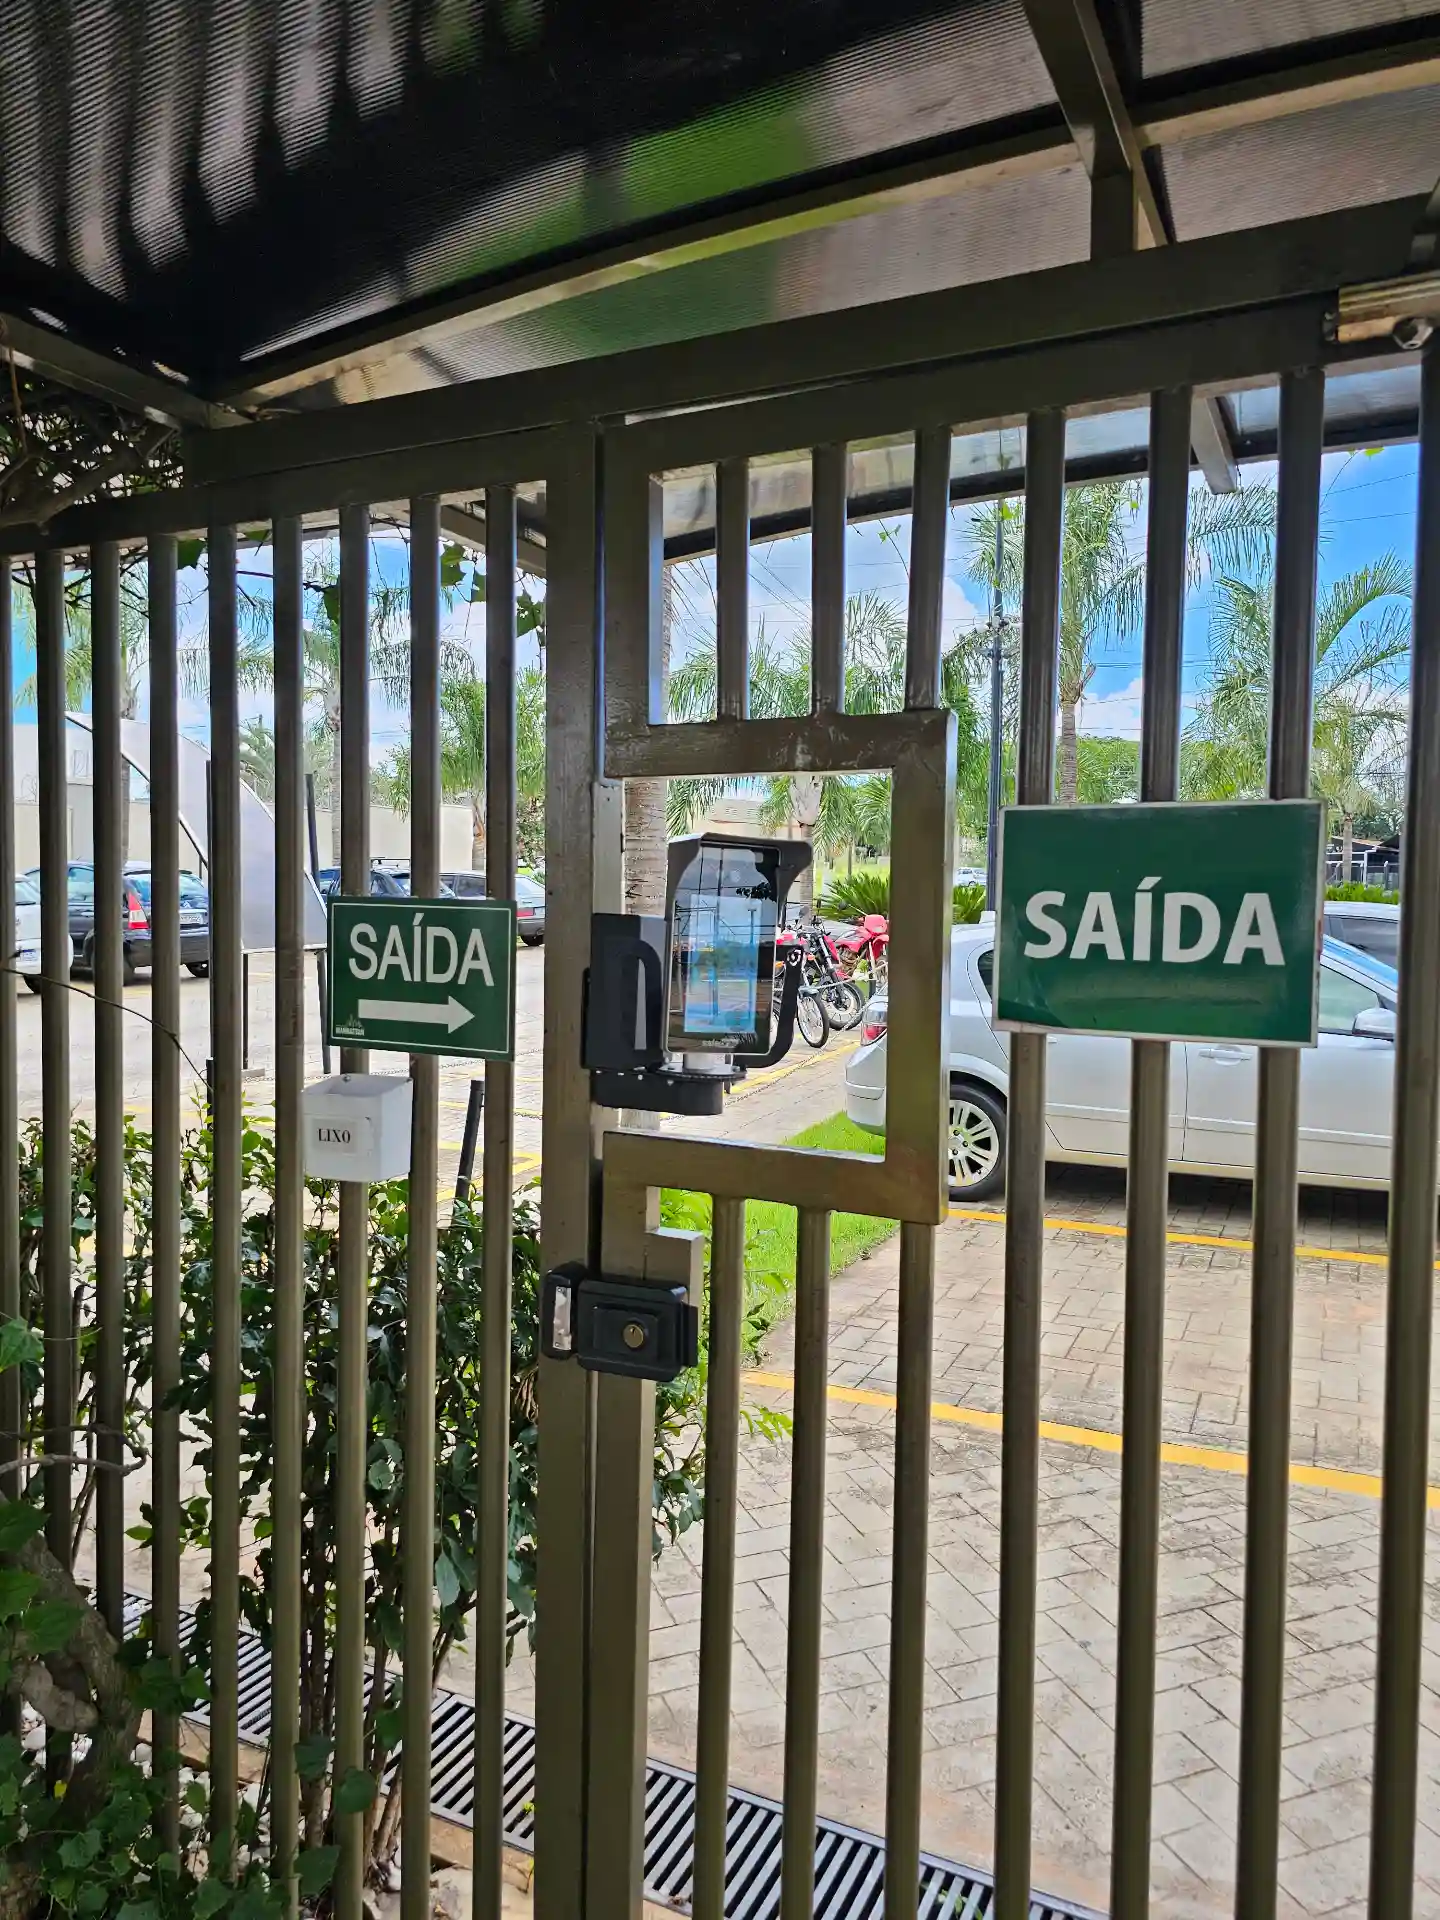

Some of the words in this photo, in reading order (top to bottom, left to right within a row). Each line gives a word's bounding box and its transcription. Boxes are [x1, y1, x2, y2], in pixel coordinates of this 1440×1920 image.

[348, 912, 495, 987] SAÍDA
[1023, 876, 1285, 966] SAÍDA
[318, 1128, 351, 1144] LIXO
